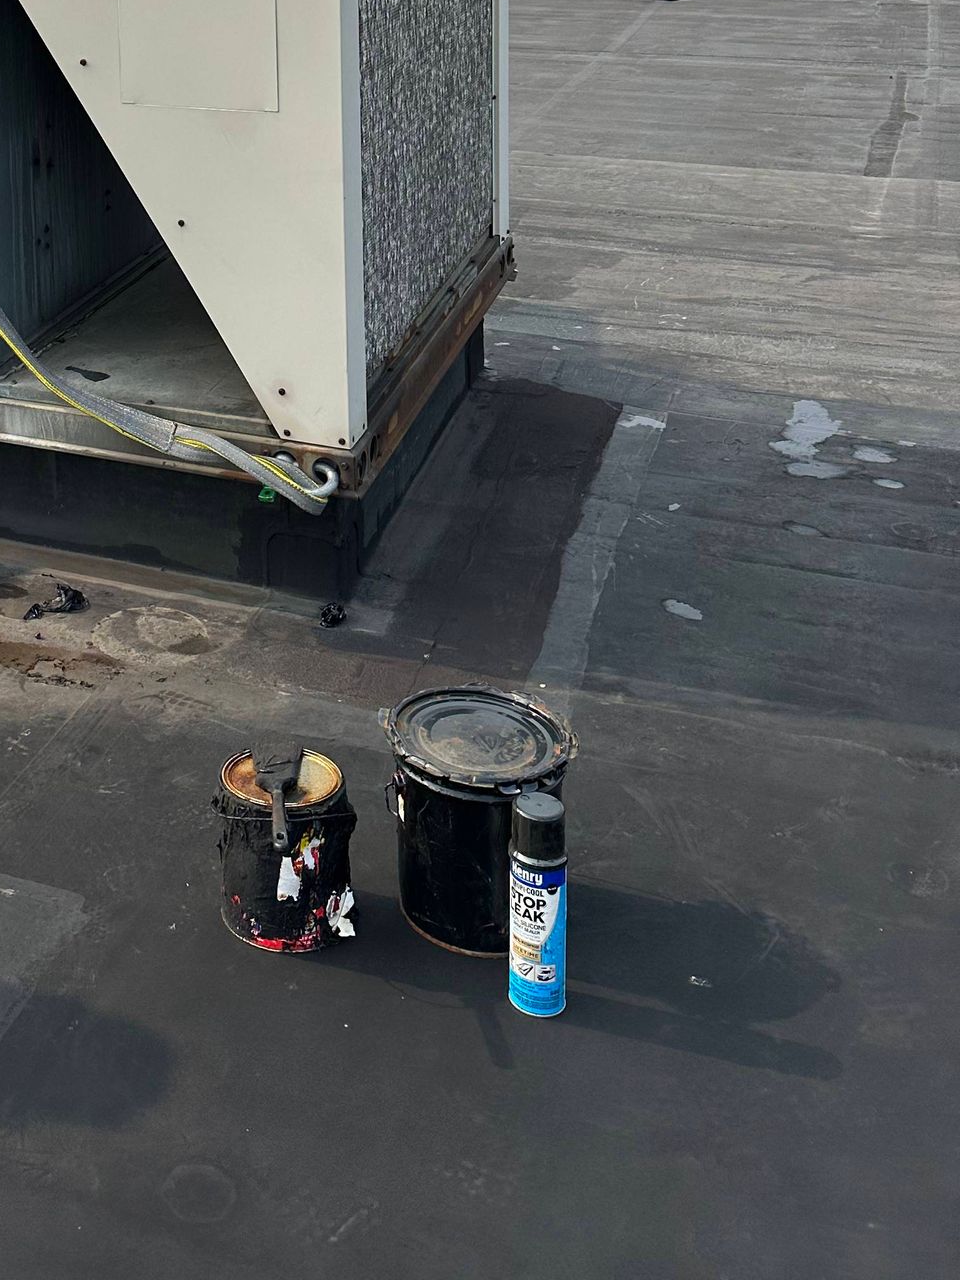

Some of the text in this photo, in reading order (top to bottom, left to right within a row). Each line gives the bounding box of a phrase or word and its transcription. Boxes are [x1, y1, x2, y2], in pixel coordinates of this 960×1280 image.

[512, 860, 543, 886] Henry
[511, 886, 547, 911] STOP
[511, 898, 545, 925] LEAK
